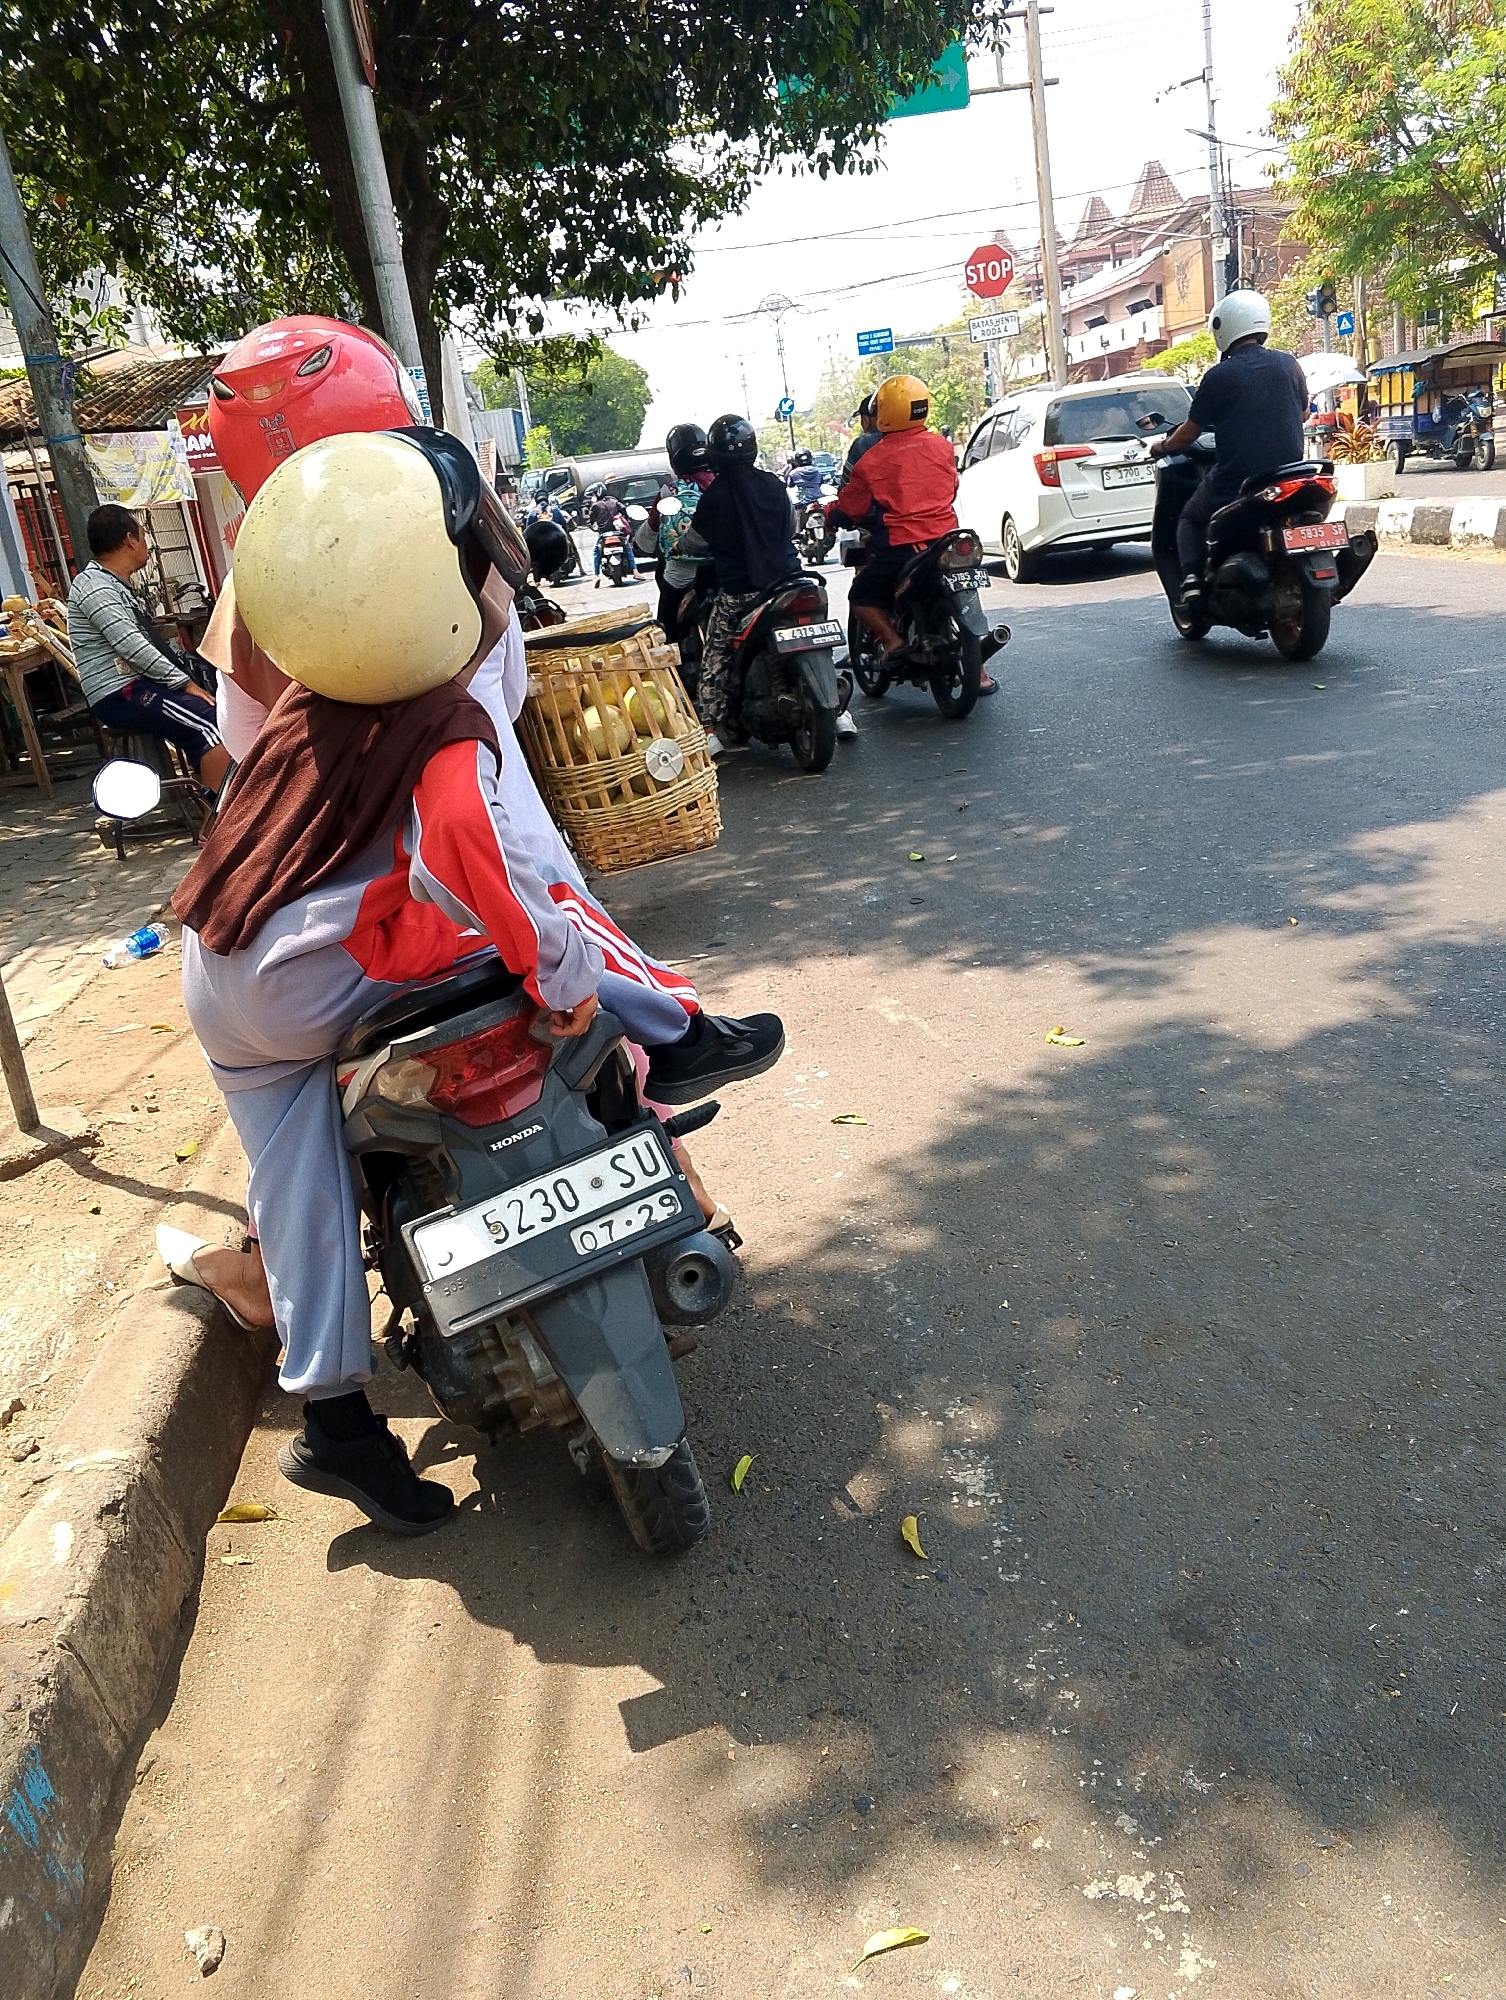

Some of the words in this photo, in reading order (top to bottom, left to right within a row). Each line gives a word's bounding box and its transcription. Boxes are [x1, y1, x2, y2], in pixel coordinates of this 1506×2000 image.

[966, 258, 1012, 285] STOP
[971, 319, 995, 330] BATAS
[995, 314, 1017, 327] HENTI
[981, 326, 1003, 338] RODA
[1104, 471, 1111, 481] S
[1118, 467, 1140, 479] 1790
[1285, 530, 1293, 541] S
[1300, 527, 1325, 540] 5835
[1332, 525, 1344, 536] SP
[777, 632, 785, 641] S
[489, 1123, 545, 1152] HONDA
[481, 1177, 580, 1245] 5230
[610, 1140, 662, 1190] SU
